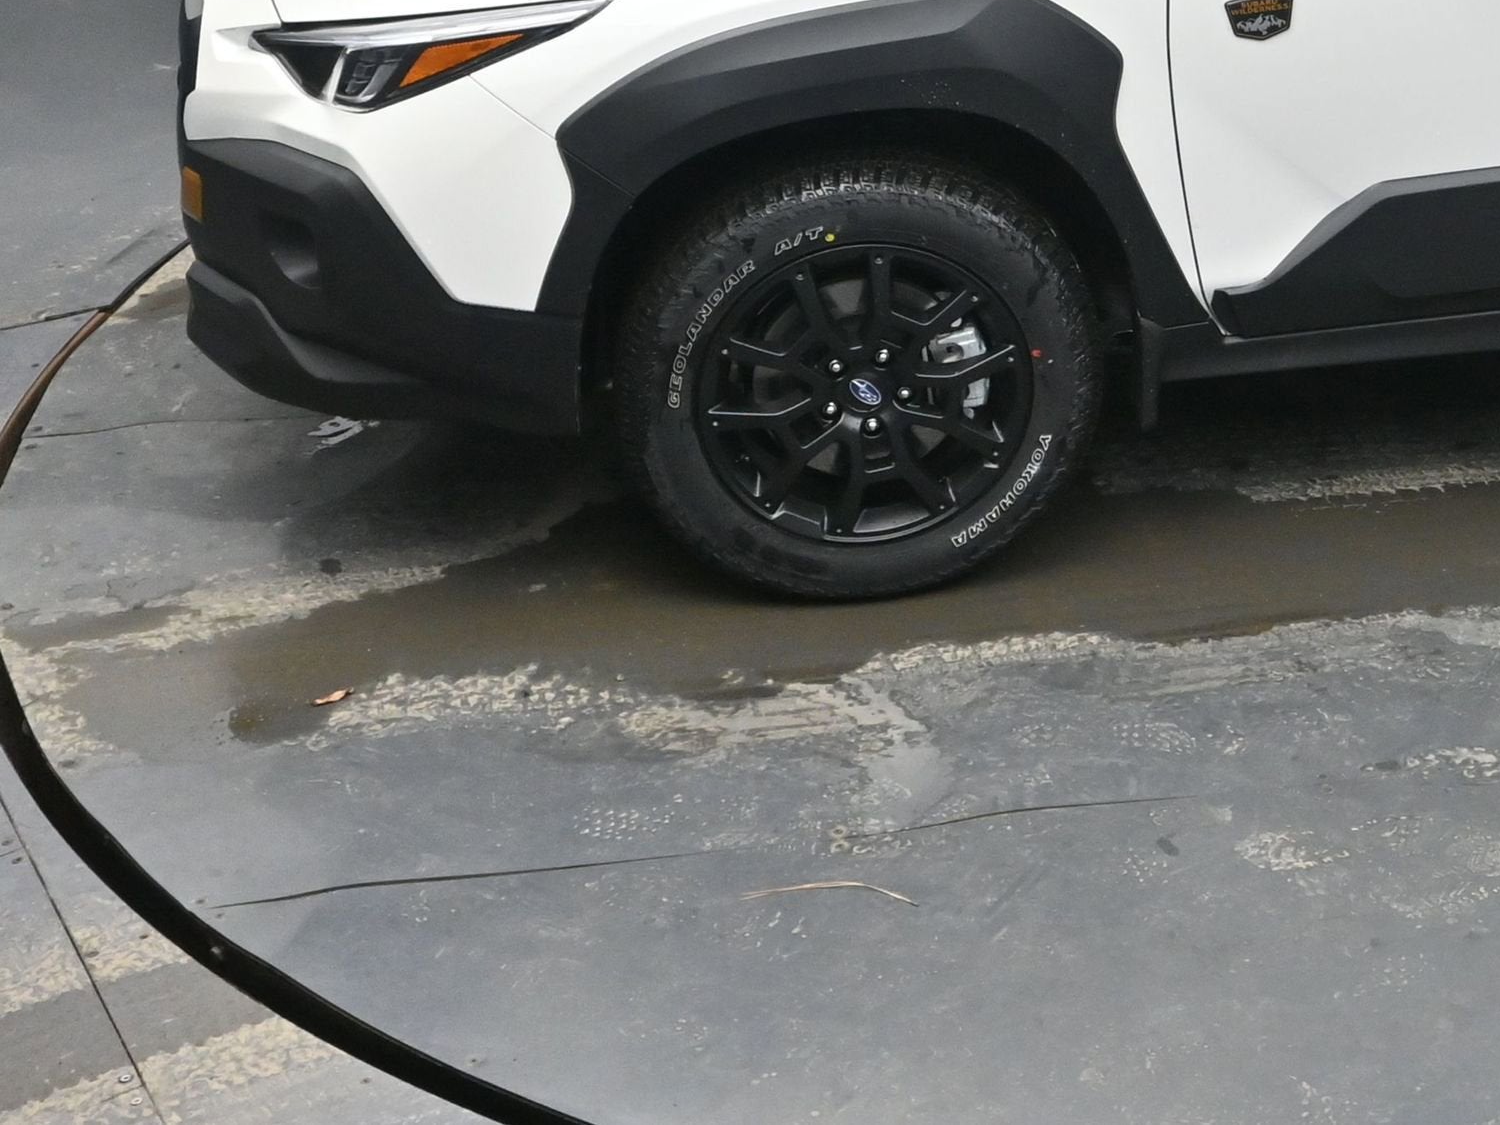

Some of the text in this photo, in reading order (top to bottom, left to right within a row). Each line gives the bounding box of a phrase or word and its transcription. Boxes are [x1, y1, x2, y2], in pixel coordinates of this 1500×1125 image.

[667, 225, 824, 409] GEOLANDAR A/T
[951, 434, 1053, 548] YOKOHAMA
